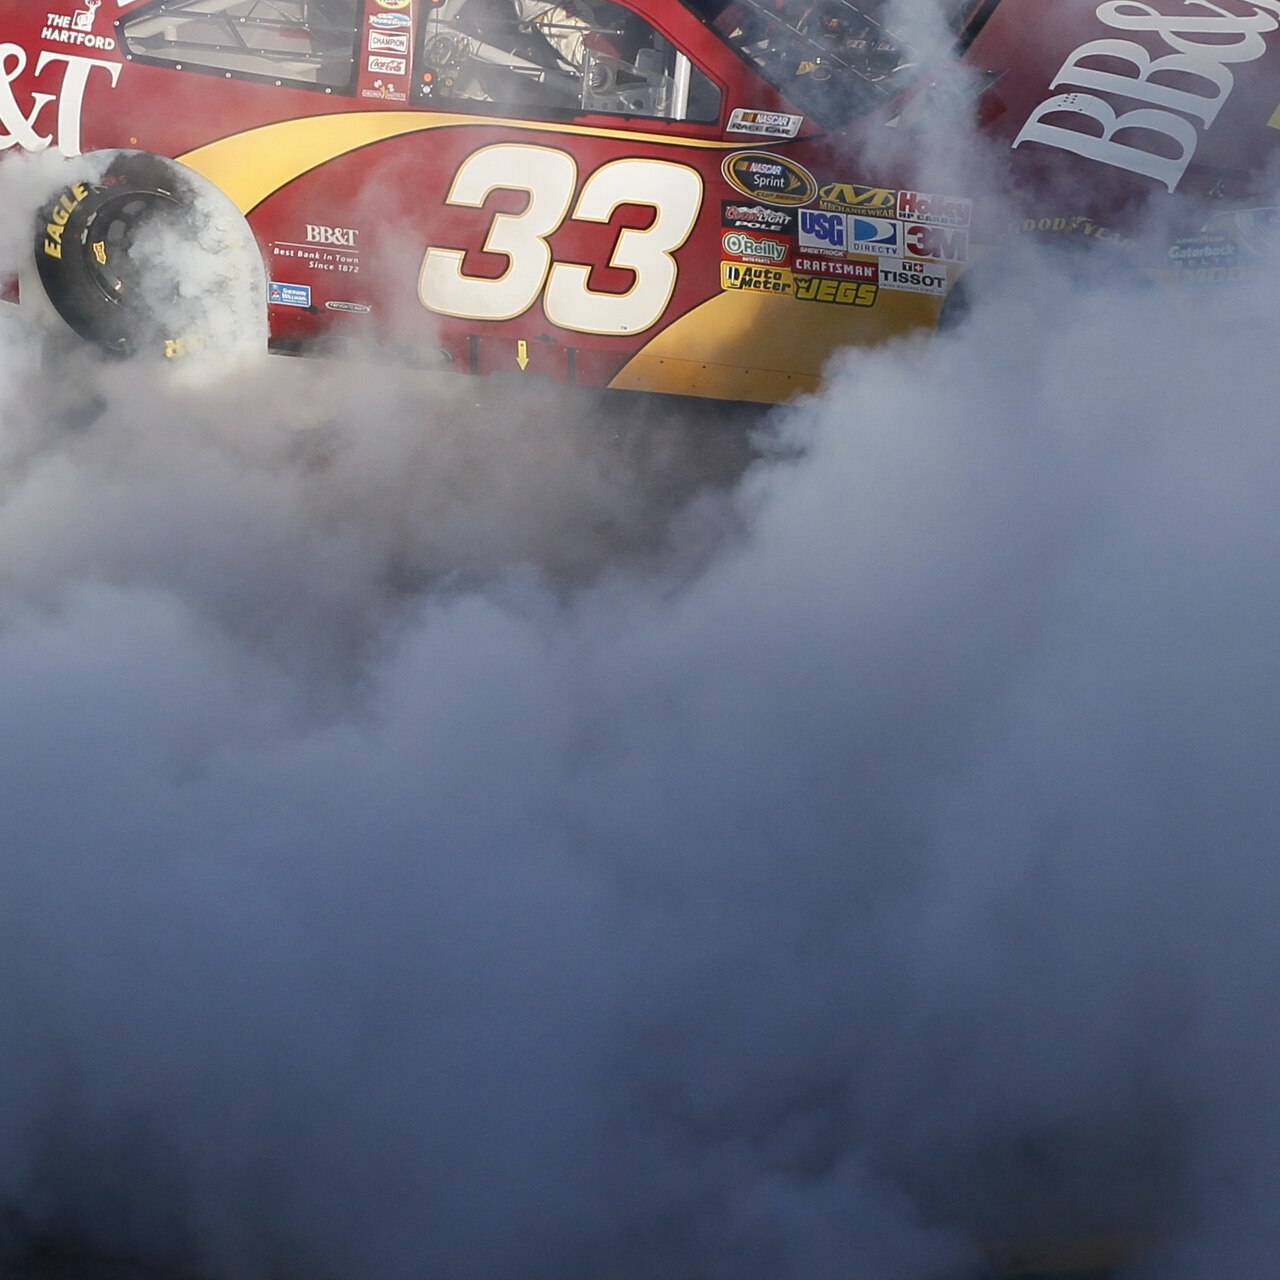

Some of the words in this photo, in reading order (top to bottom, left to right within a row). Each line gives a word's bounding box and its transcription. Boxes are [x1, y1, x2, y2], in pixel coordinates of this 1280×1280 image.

[47, 13, 72, 28] THE
[40, 27, 116, 50] HARTFORD
[372, 35, 406, 48] CHAMPION
[755, 113, 789, 126] NASCAR
[732, 123, 764, 132] RACE
[764, 126, 791, 135] CAR
[749, 162, 783, 176] NASCAR
[753, 174, 785, 188] Sprint
[868, 207, 895, 218] WEAR
[898, 191, 970, 226] Holley
[44, 182, 89, 260] EAGLE
[734, 220, 783, 232] POLE
[757, 212, 793, 225] LIGHT
[305, 224, 359, 246] BB&T
[800, 211, 844, 247] USG
[417, 142, 704, 336] 33
[724, 232, 787, 261] O'Reilly
[906, 225, 969, 263] 3M
[273, 247, 295, 257] Best
[297, 250, 321, 260] Bank
[323, 253, 333, 261] In
[335, 254, 359, 264] Town
[853, 243, 898, 255] DIRECTV
[308, 260, 335, 271] Since
[337, 264, 360, 274] 1872
[743, 267, 783, 281] Auto
[795, 259, 873, 277] CRAFTSMAN
[742, 277, 792, 292] Meter
[880, 269, 946, 289] TISSOT
[797, 278, 878, 306] JEGS
